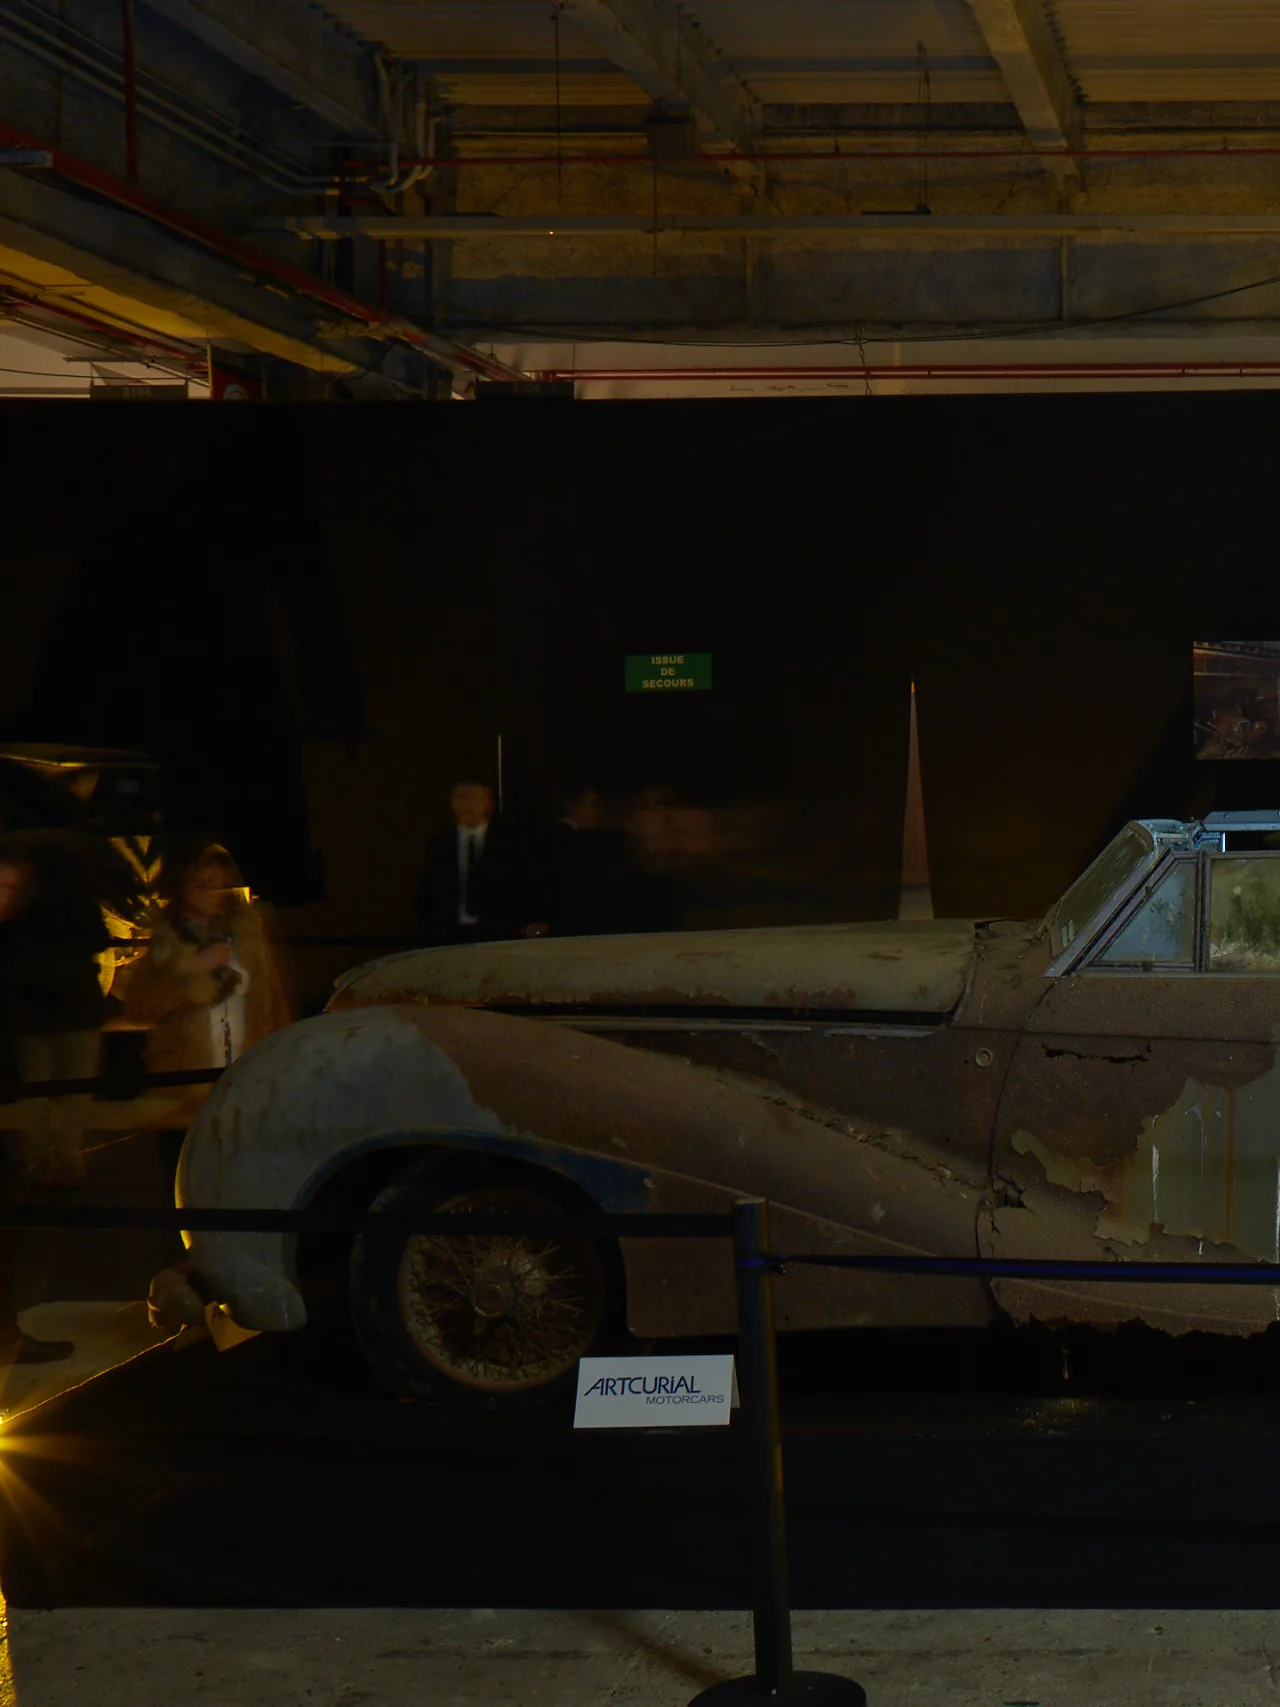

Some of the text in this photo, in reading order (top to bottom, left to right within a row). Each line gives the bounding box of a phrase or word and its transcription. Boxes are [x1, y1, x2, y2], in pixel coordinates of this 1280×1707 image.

[123, 387, 152, 397] 2104
[651, 655, 685, 665] ISSUE
[660, 667, 676, 676] DE
[642, 678, 695, 689] SECOURS
[646, 1394, 725, 1405] MOTORCARS
